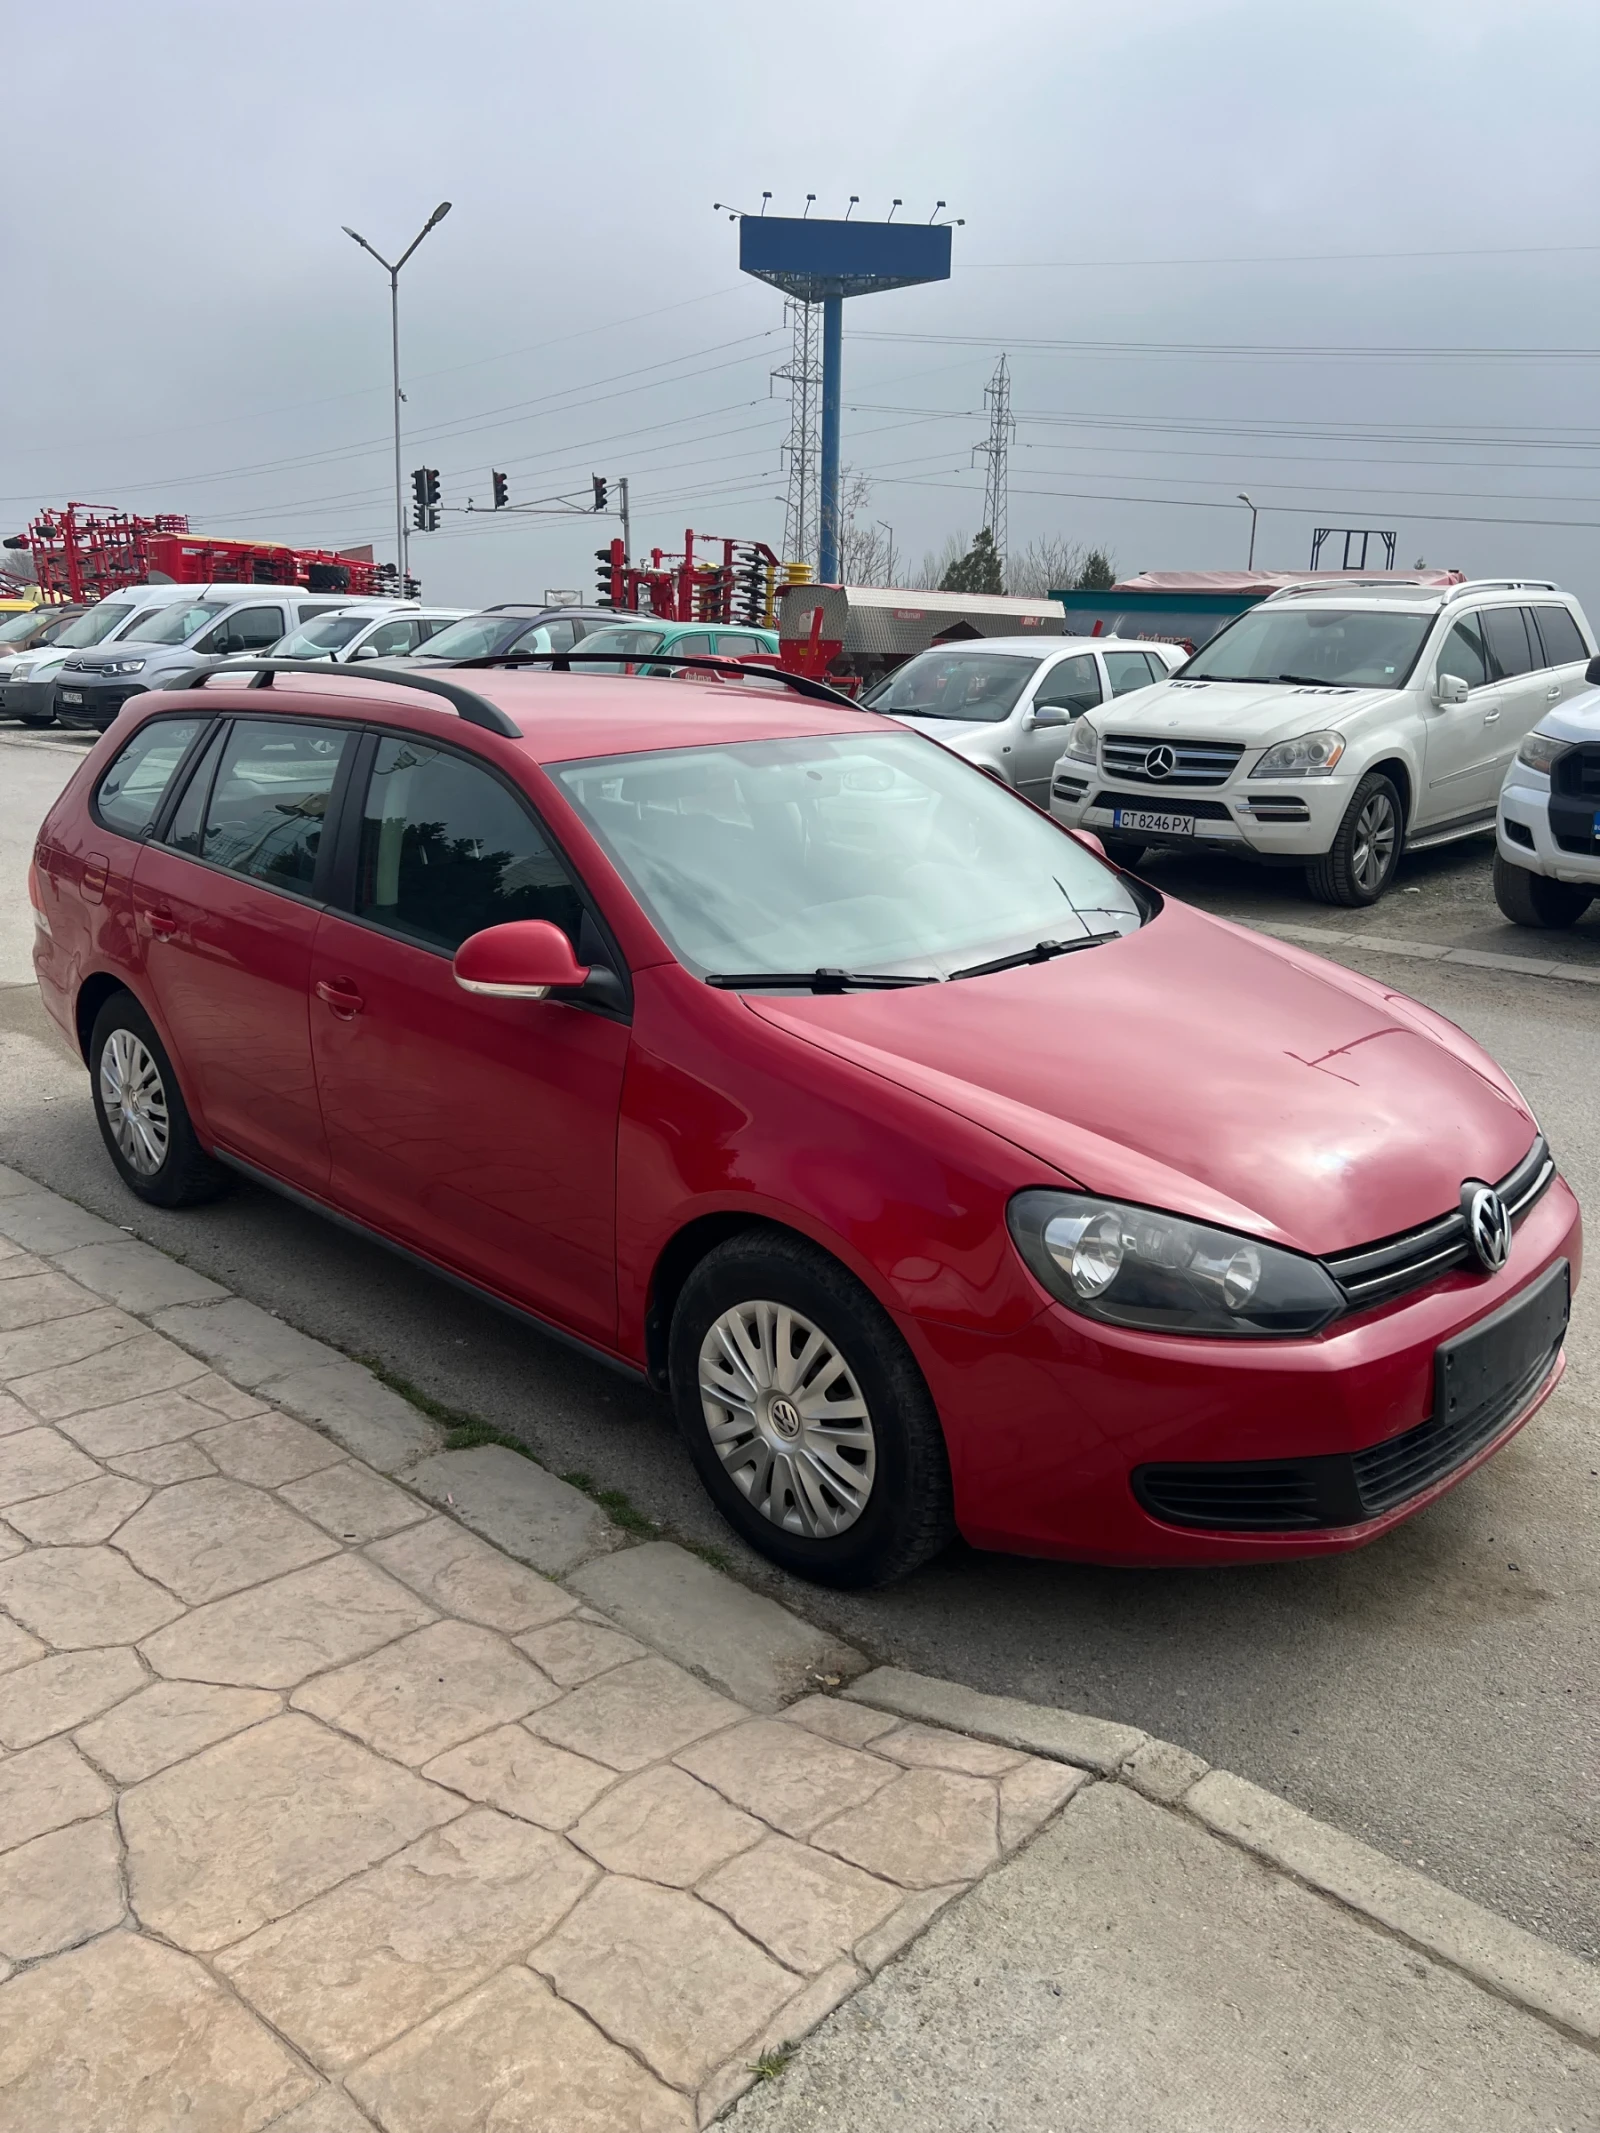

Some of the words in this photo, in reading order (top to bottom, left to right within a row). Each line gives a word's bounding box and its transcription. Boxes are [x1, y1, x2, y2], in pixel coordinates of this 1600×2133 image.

[1121, 812, 1138, 827] CT
[1139, 814, 1170, 830] 8246
[1172, 817, 1191, 833] PX
